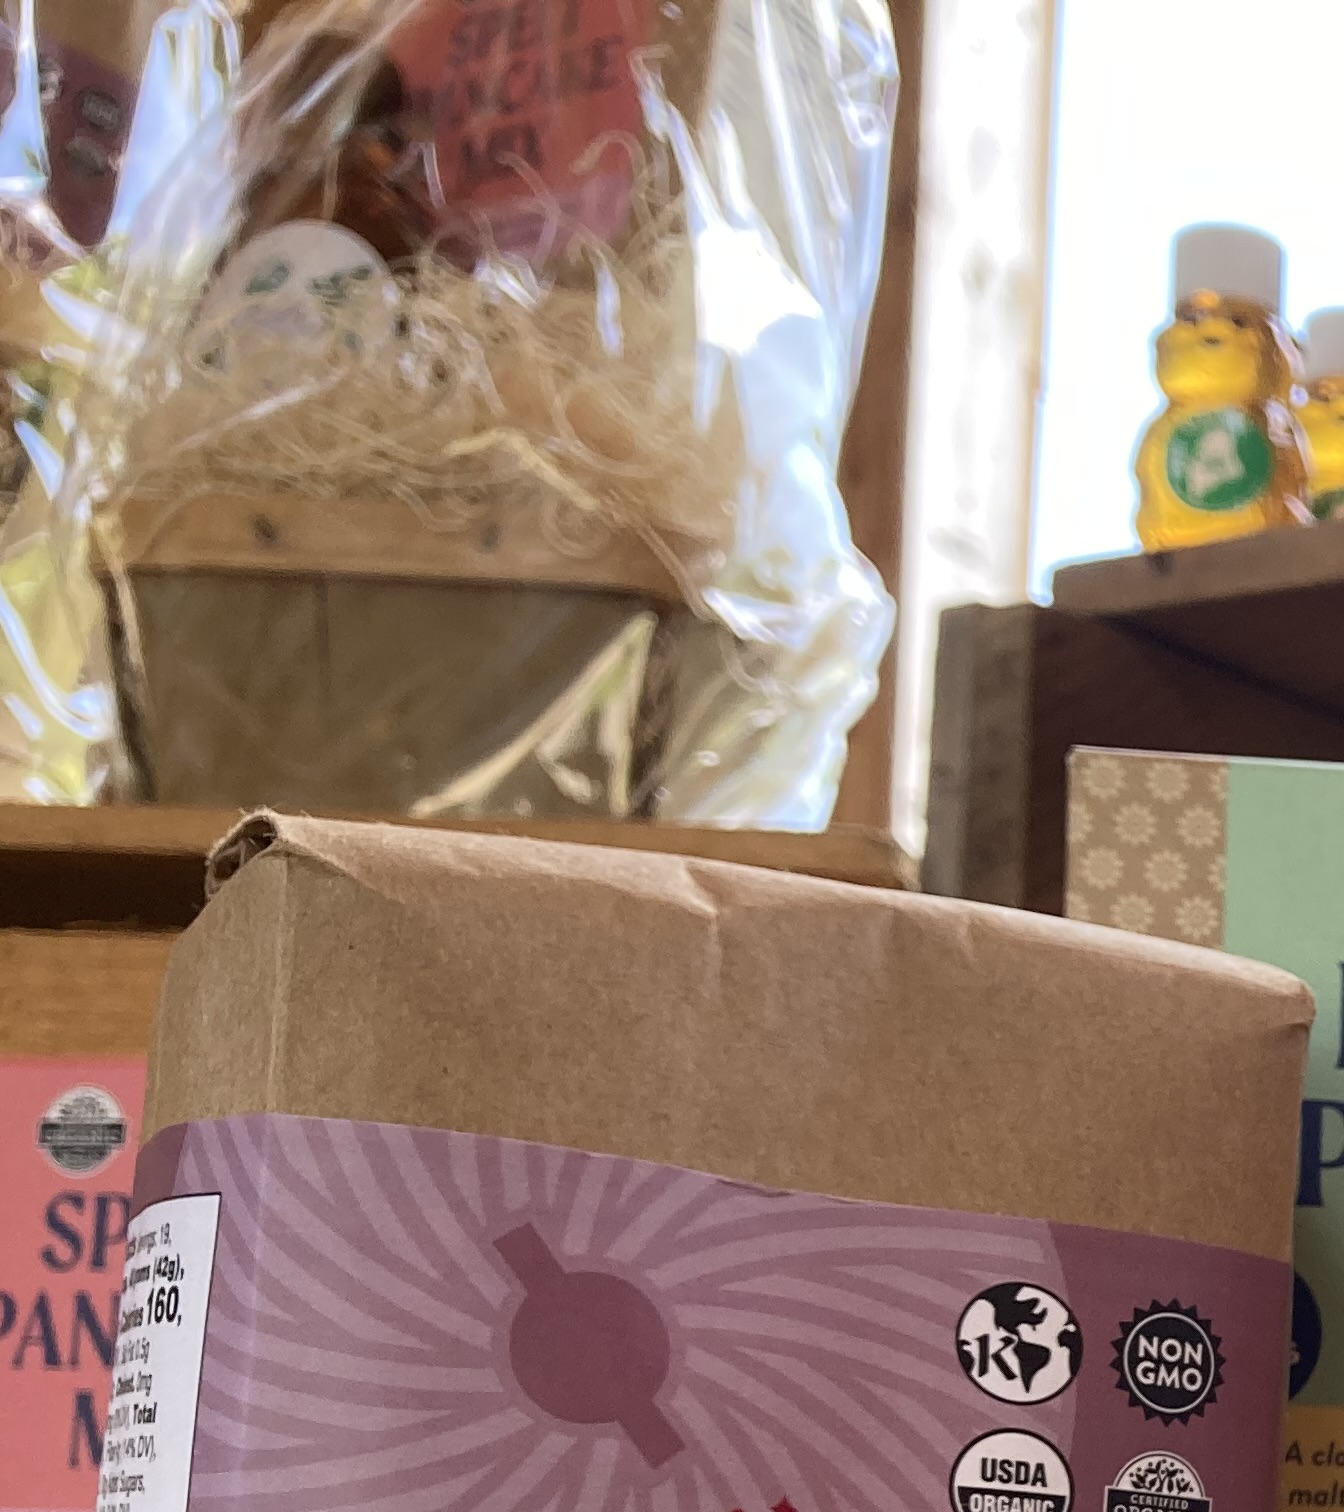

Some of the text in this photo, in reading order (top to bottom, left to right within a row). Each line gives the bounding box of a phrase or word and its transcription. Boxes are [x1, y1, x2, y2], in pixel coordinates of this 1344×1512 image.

[147, 1285, 182, 1327] 160,
[1137, 1334, 1203, 1366] NON
[1136, 1361, 1202, 1392] GMO
[1285, 1440, 1301, 1464] A
[980, 1456, 1048, 1488] USDA
[1130, 1493, 1189, 1510] CERTIFIED
